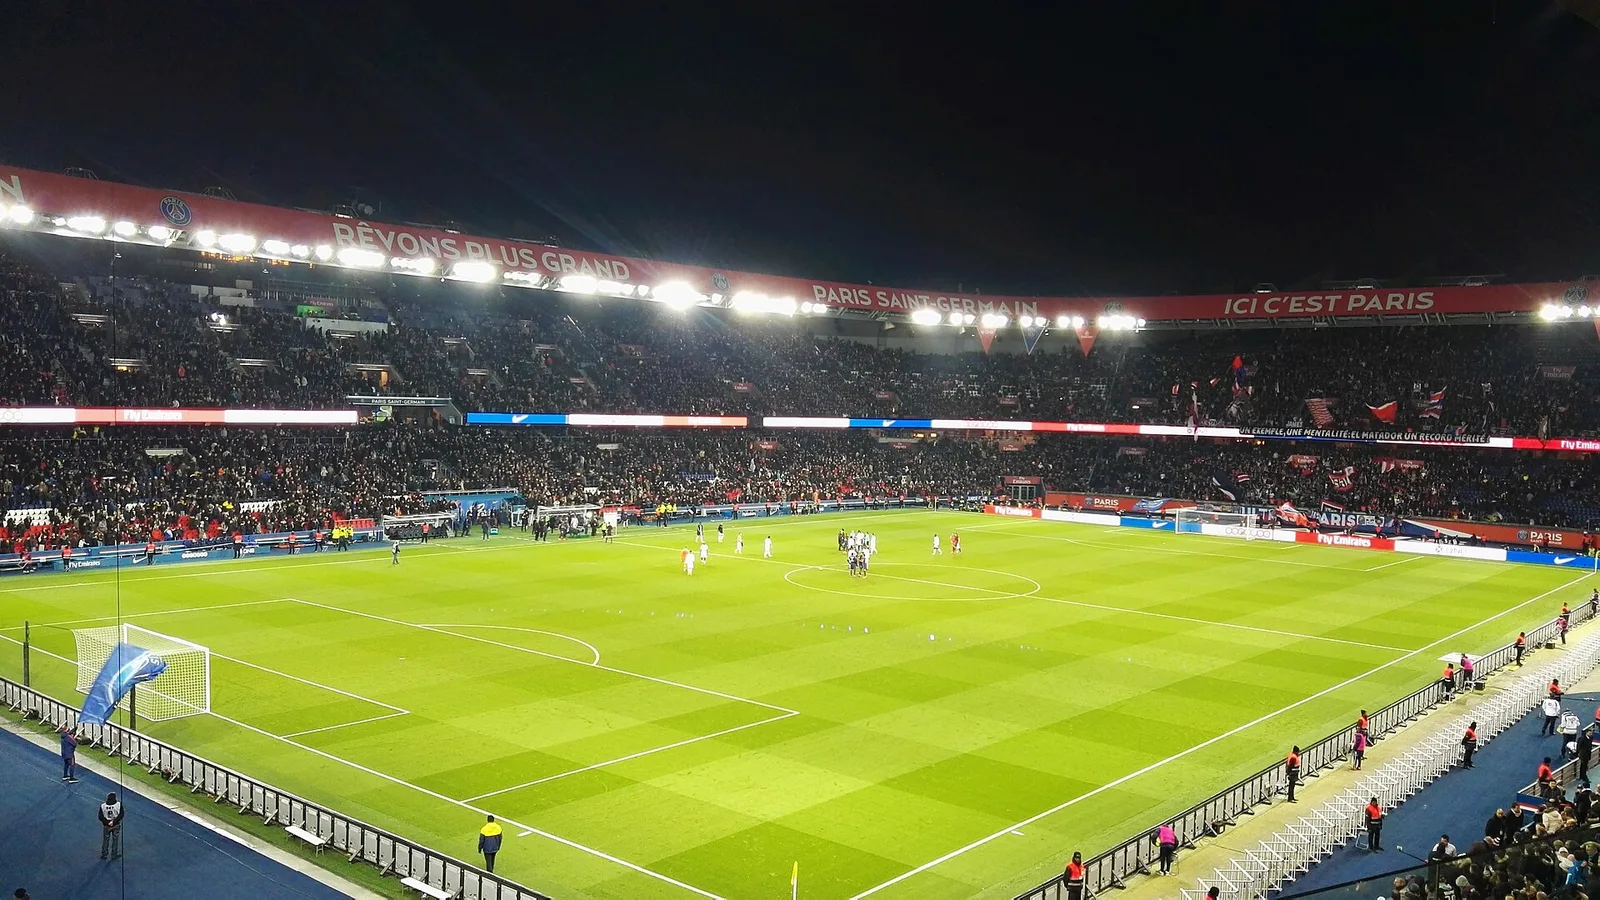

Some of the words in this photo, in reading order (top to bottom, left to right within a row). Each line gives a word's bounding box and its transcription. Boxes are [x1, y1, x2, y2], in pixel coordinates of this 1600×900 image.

[332, 221, 461, 260] RÊVONS
[465, 241, 538, 269] PLUS
[541, 252, 630, 280] GRAND
[812, 285, 872, 306] PARIS
[876, 291, 1037, 316] SAINT-GERMAIN
[1224, 298, 1258, 314] ICI
[1263, 295, 1342, 313] C'EST
[1347, 292, 1434, 311] PARIS
[1361, 432, 1403, 440] MATADOR
[1419, 432, 1452, 441] RECORD
[1561, 440, 1575, 450] Fly
[1094, 498, 1119, 506] PARIS
[1318, 533, 1333, 545] Fly
[1333, 535, 1371, 547] Emirates
